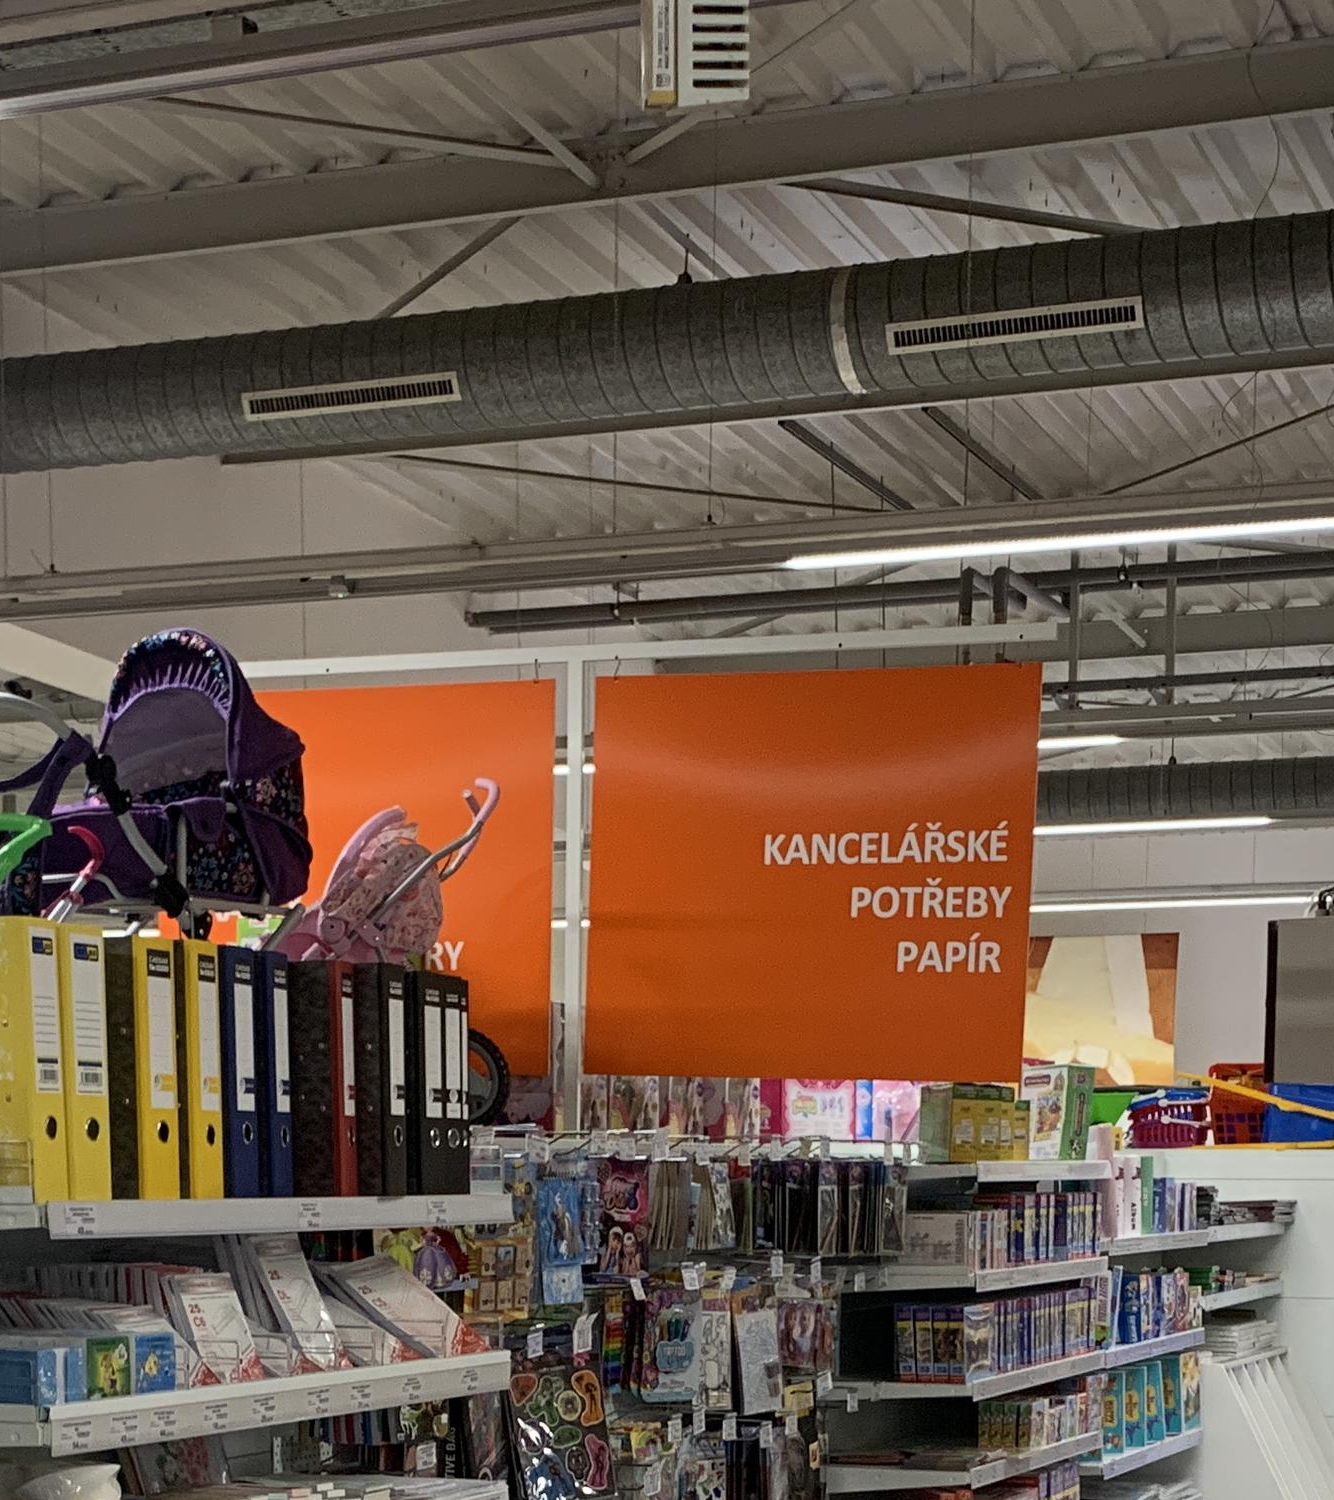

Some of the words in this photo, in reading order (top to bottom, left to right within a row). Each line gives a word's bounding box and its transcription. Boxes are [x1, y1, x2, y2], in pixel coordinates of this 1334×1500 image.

[764, 821, 1009, 866] KANCELÁŘSKÉ
[851, 878, 1011, 919] POTŘEBY
[897, 933, 1002, 973] PAPÍR
